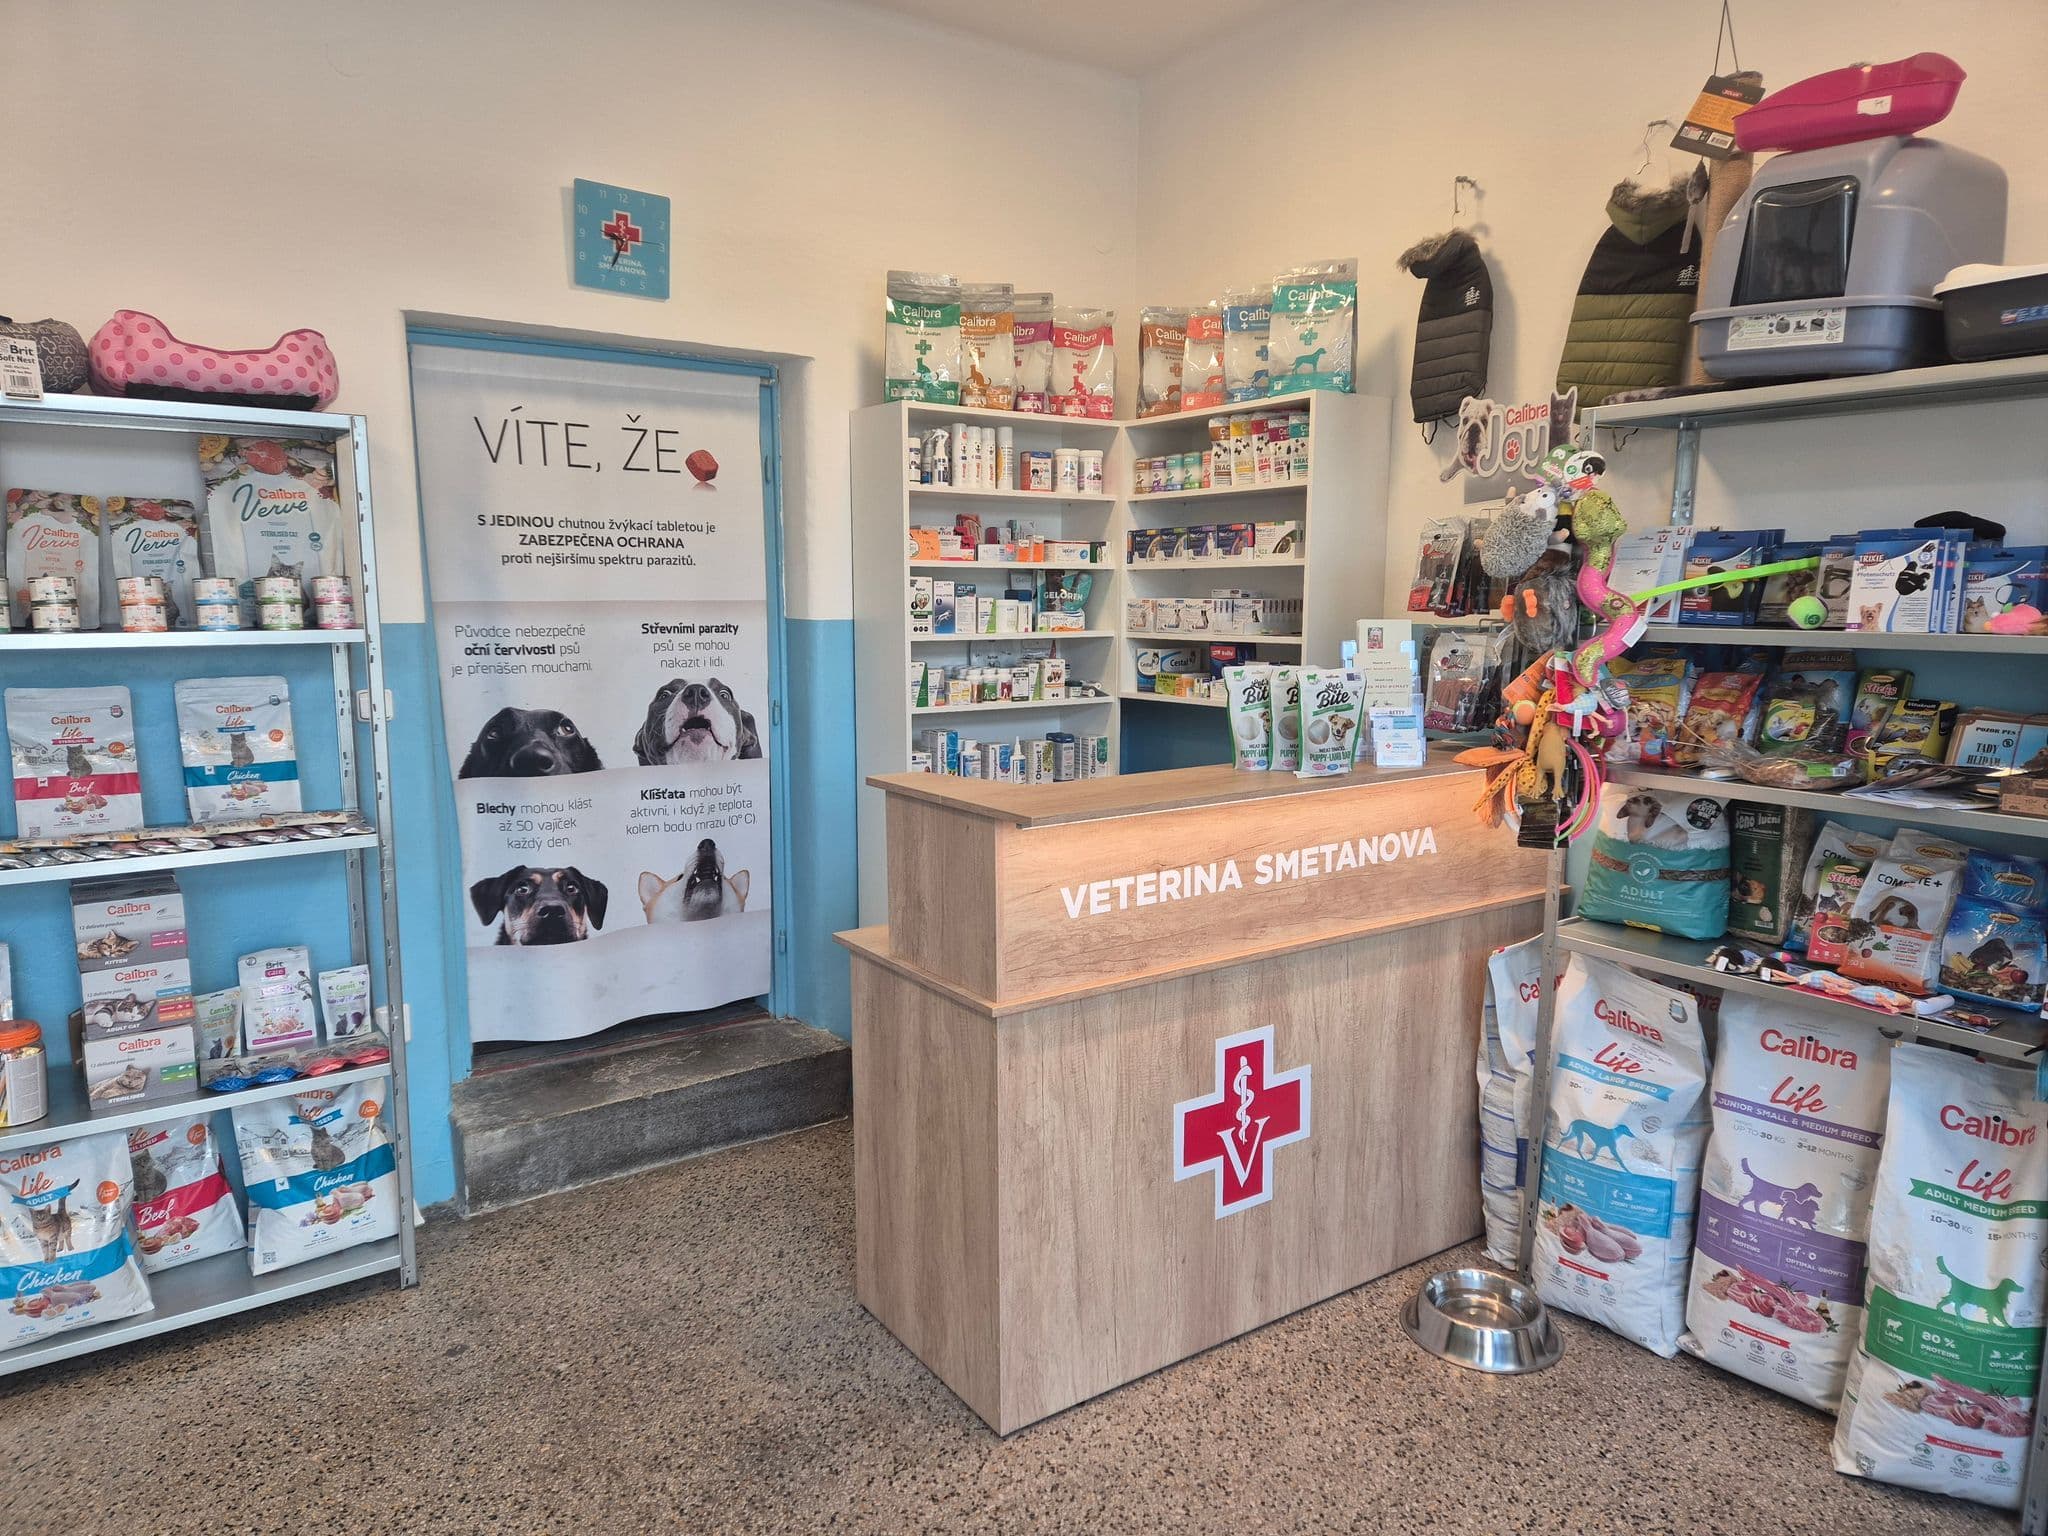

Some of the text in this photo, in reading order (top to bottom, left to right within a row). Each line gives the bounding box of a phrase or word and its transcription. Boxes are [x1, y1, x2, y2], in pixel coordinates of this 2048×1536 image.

[902, 305, 942, 318] Calibra
[1239, 308, 1270, 321] Calib
[960, 316, 996, 328] Calibra
[1063, 331, 1098, 343] Calibra
[10, 344, 34, 356] Brit
[1506, 402, 1549, 426] Calibra
[474, 405, 681, 474] VÍTE, ŽE
[258, 487, 308, 500] Calibra
[231, 483, 309, 522] Verve
[477, 514, 716, 535] S JEDINOU chutnou žvýkací tabletou je
[21, 524, 81, 551] Verve
[43, 527, 81, 539] Calibra
[125, 527, 180, 554] Verve
[144, 529, 179, 539] Calibra
[519, 532, 685, 549] ZABEZPEČENA OCHRANA
[502, 552, 697, 567] proti nejširšímu spektru parazitů.
[455, 624, 586, 640] Původce nebezpečné
[641, 622, 739, 636] Střevními parazity
[464, 641, 581, 657] oční červivosti psů
[653, 639, 730, 653] psů se mohou
[451, 661, 593, 678] je přenášen mouchami.
[660, 657, 700, 669] nakazit
[1169, 659, 1189, 668] Cestal
[1316, 690, 1351, 708] Bite
[215, 703, 252, 714] Calibra
[51, 715, 91, 726] Calibra
[223, 715, 244, 728] Life
[61, 726, 84, 739] Life
[1976, 742, 1999, 754] TADY
[227, 769, 260, 781] Chicken
[68, 781, 95, 795] Beef
[640, 783, 742, 801] Klíšťata mohou být
[476, 797, 592, 816] Blechy mohou klást
[630, 804, 669, 819] aktivní,
[680, 802, 705, 817] když
[707, 802, 716, 816] je
[718, 799, 753, 814] teplota
[499, 817, 577, 834] až 50 vajíček
[626, 822, 660, 836] kolem
[663, 821, 692, 833] bodu
[696, 818, 726, 831] mrazu
[507, 835, 572, 851] každý den.
[1060, 826, 1438, 919] VETERINA SMETANOVA
[1620, 885, 1665, 900] ADULT
[107, 902, 151, 916] Calibra
[114, 968, 158, 982] Calibra
[1594, 999, 1664, 1044] Calibra
[118, 1038, 162, 1052] Calibra
[1759, 1028, 1858, 1071] Calibra
[1592, 1041, 1644, 1075] Life
[1567, 1061, 1658, 1093] ADULT LARGE BREED
[1769, 1076, 1829, 1113] Life
[1718, 1097, 1872, 1144] JUNIOR SMALL & MEDIUM BREED
[1940, 1104, 2036, 1147] Calibra
[1759, 1131, 1773, 1141] 30
[0, 1144, 63, 1175] Calibra
[1818, 1147, 1854, 1163] MONTHS
[18, 1171, 54, 1197] Life
[313, 1171, 355, 1192] Chicken
[26, 1194, 54, 1207] ADULT
[1924, 1187, 1961, 1205] ADULT
[1963, 1201, 2008, 1217] MEDIUM
[139, 1198, 176, 1226] Beef
[1732, 1227, 1758, 1243] 80 %
[1962, 1225, 1974, 1235] KG
[1731, 1238, 1761, 1254] PROTEINS
[1785, 1257, 1849, 1278] OPTIMAL GROWTH
[17, 1268, 82, 1293] Chicken
[1921, 1331, 1956, 1349] 80 %
[1920, 1344, 1961, 1361] PROTEINS
[1988, 1361, 2023, 1371] OPTIMAL
